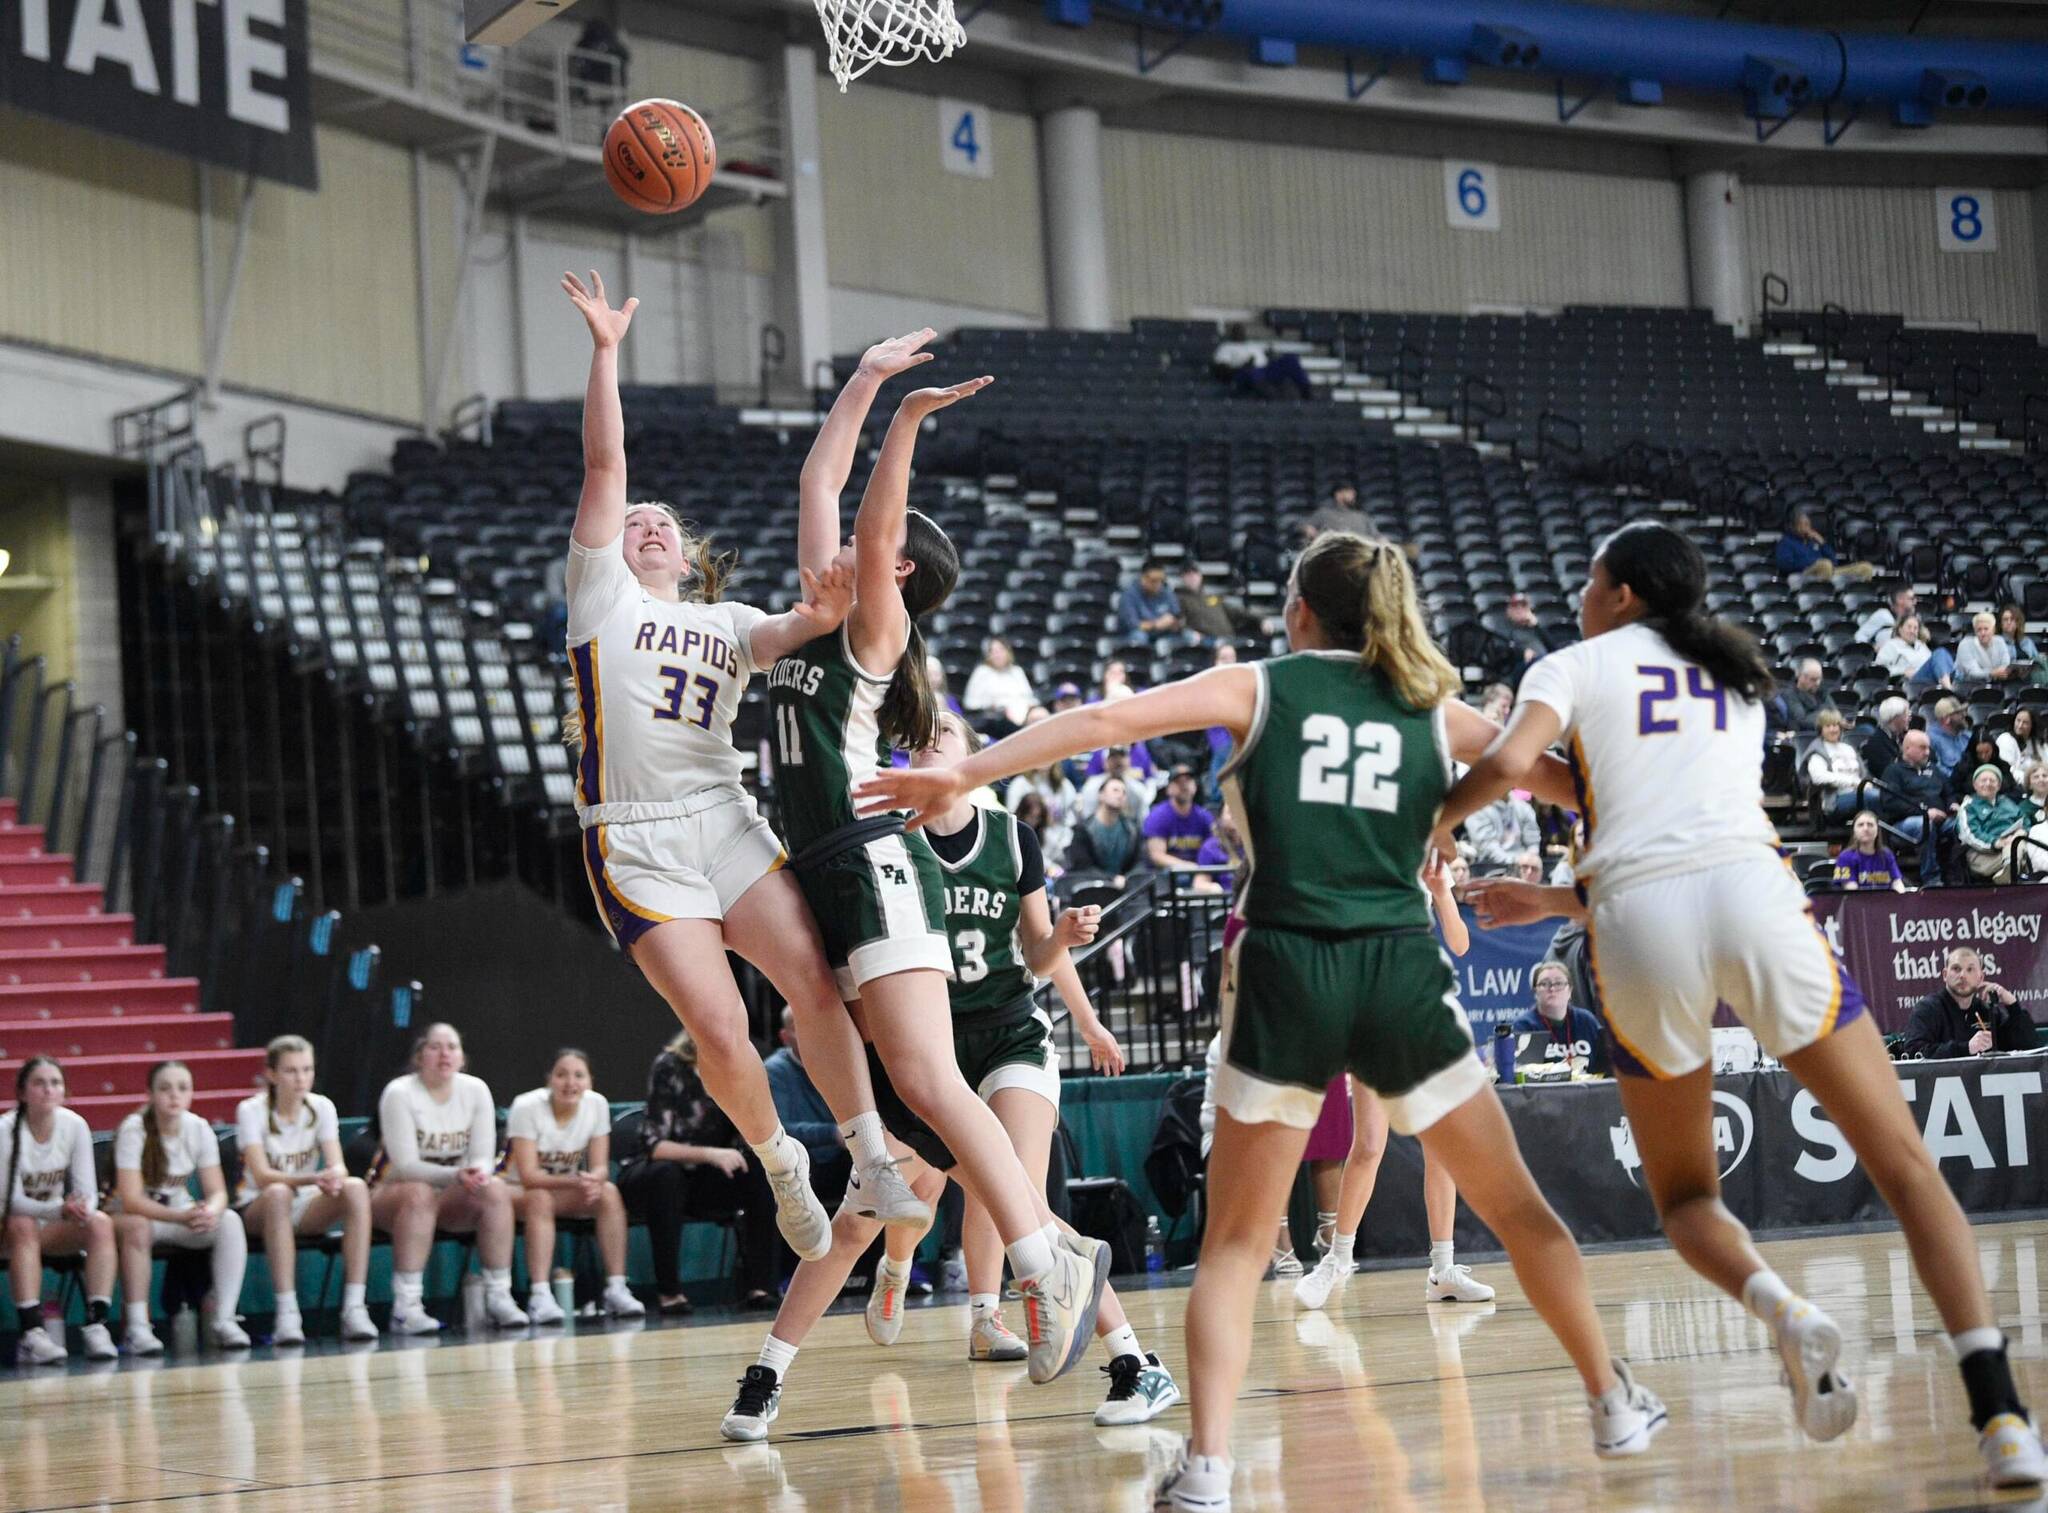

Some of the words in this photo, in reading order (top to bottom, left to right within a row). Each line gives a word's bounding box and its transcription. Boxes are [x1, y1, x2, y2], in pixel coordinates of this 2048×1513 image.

[952, 111, 981, 165] 4
[1459, 169, 1487, 217] 6
[1951, 196, 1982, 241] 8
[634, 621, 738, 679] RAPIDS
[653, 665, 720, 731] 33
[1635, 664, 1727, 736] 24
[777, 704, 803, 765] 11
[1299, 713, 1402, 814] 22
[881, 864, 907, 885] PA
[1890, 913, 1953, 943] Leave
[1956, 917, 1972, 940] a
[1971, 908, 2042, 945] legacy
[1467, 964, 1522, 997] LAW
[1893, 949, 1941, 981] that
